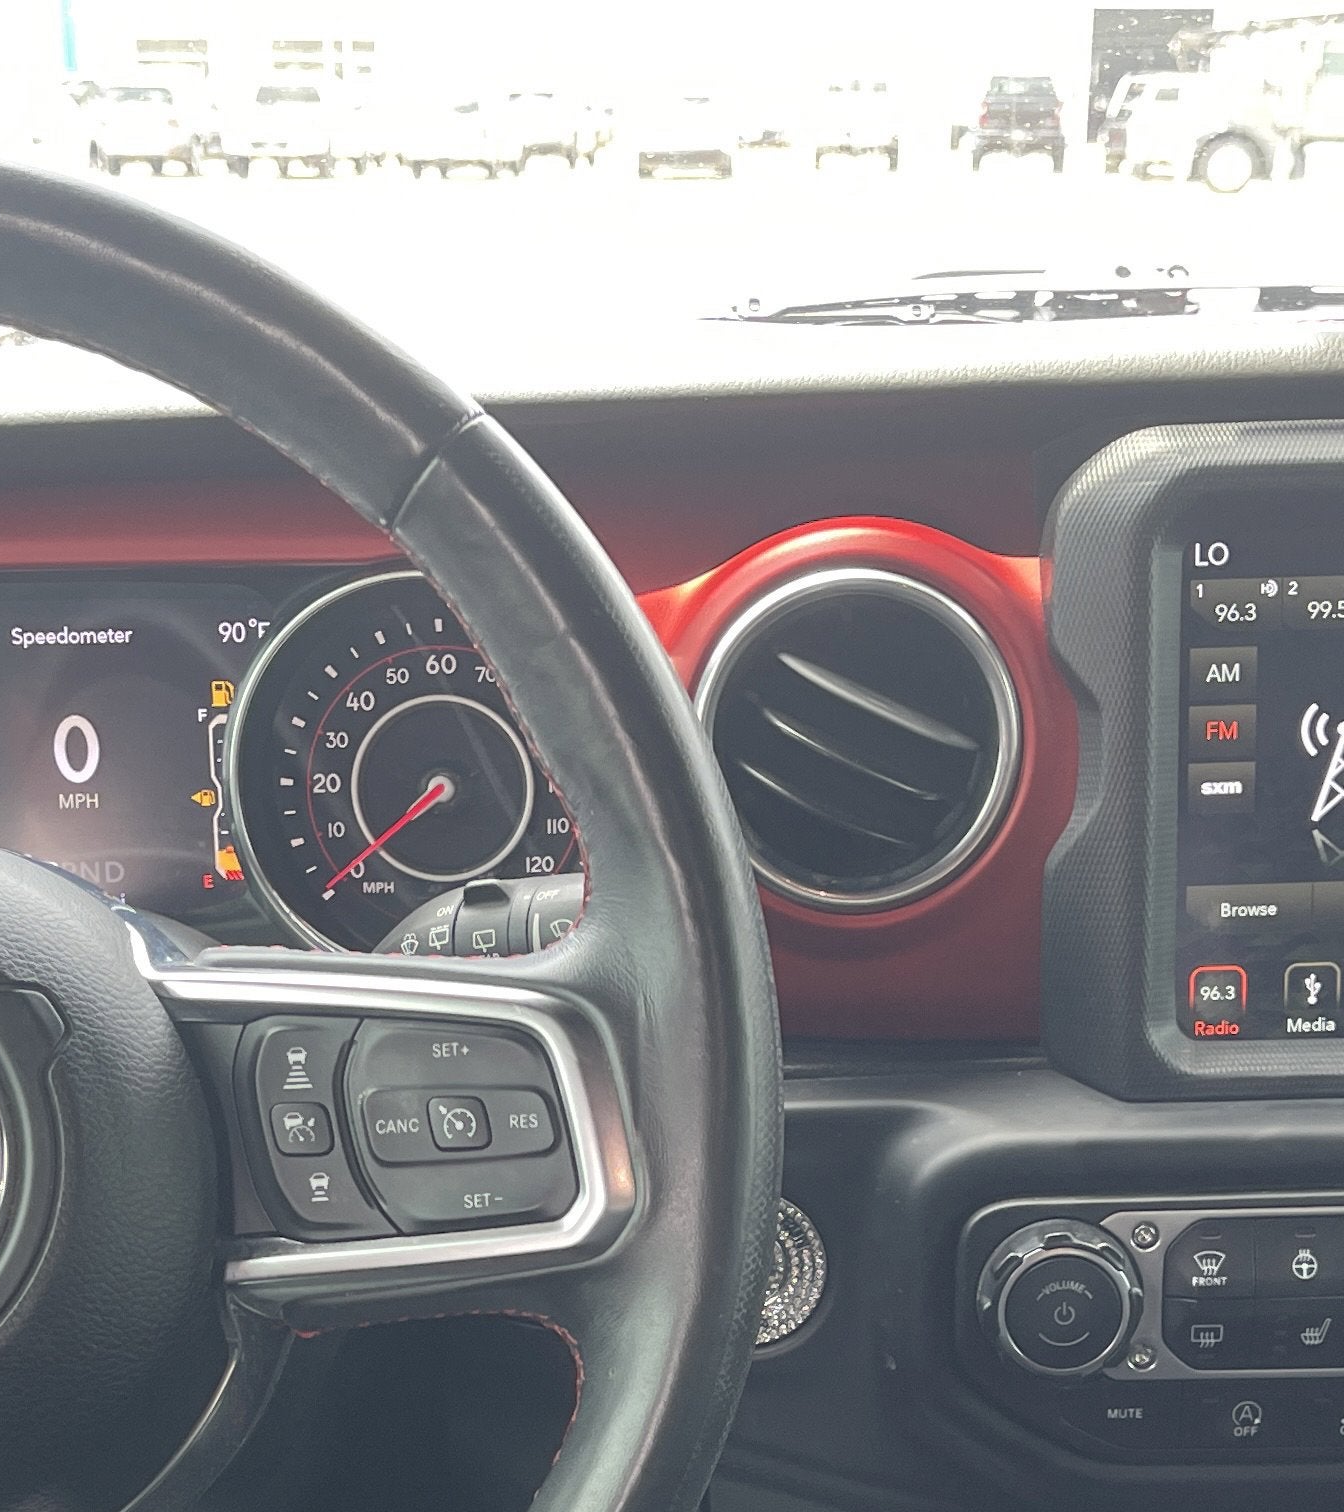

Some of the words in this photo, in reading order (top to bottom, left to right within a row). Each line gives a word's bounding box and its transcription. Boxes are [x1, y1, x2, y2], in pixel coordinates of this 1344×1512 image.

[1194, 542, 1230, 566] LO
[1196, 584, 1204, 598] 1
[1288, 581, 1298, 595] 2
[1215, 603, 1257, 622] 96.3
[11, 627, 133, 648] Speedometer
[425, 654, 457, 675] 60
[386, 668, 409, 684] 50
[1205, 664, 1241, 682] AM
[346, 691, 375, 711] 40
[197, 709, 208, 722] F
[1205, 722, 1238, 741] FM
[326, 732, 349, 748] 30
[54, 715, 100, 784] 0
[313, 773, 341, 793] 20
[58, 794, 99, 809] MPH
[328, 822, 345, 838] 10
[547, 818, 569, 834] 110
[526, 856, 554, 873] 120
[202, 874, 214, 889] E
[363, 882, 394, 893] MPH
[536, 889, 560, 900] OFF
[437, 905, 455, 917] ON
[1220, 902, 1277, 918] Browse
[1200, 985, 1236, 1001] 96.3
[1194, 1021, 1239, 1036] Radio
[1286, 1018, 1336, 1033] Media
[376, 1118, 419, 1134] CANC
[509, 1114, 538, 1129] RES
[1042, 1280, 1086, 1295] VOLUME
[1192, 1276, 1227, 1287] FRONT
[1107, 1408, 1143, 1420] MUTE
[1234, 1426, 1258, 1437] OFF
